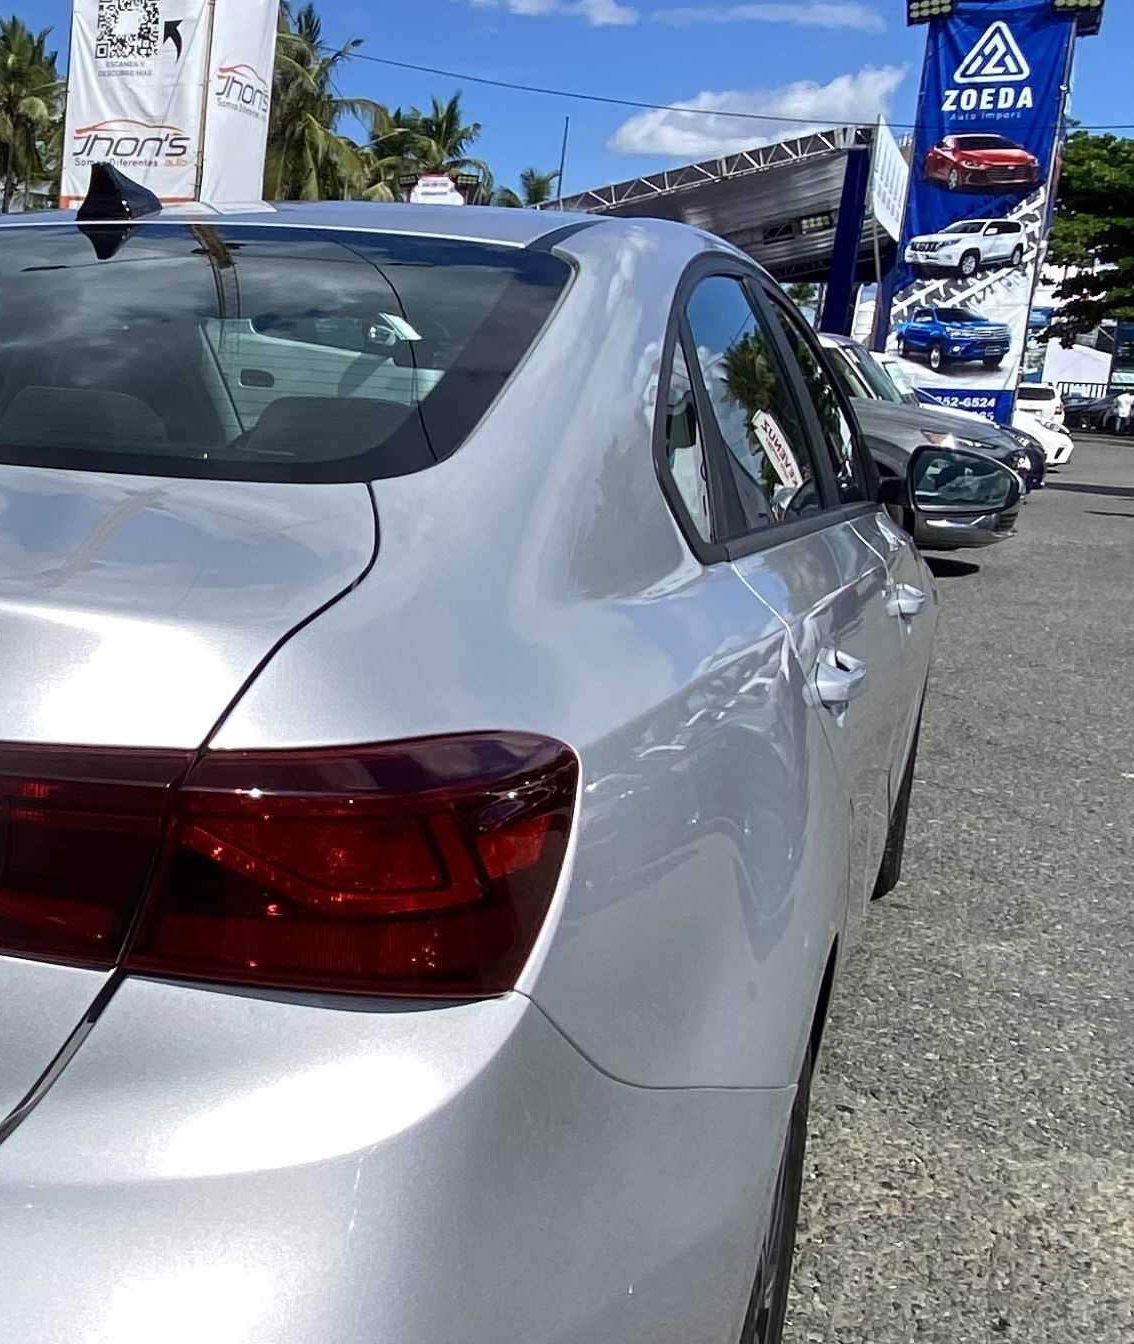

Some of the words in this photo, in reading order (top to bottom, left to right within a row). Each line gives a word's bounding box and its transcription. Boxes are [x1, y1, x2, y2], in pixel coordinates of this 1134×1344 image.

[941, 86, 1034, 112] ZOEDA
[949, 112, 978, 121] Auto
[73, 133, 191, 157] Jhon's
[109, 158, 158, 167] Diferentes
